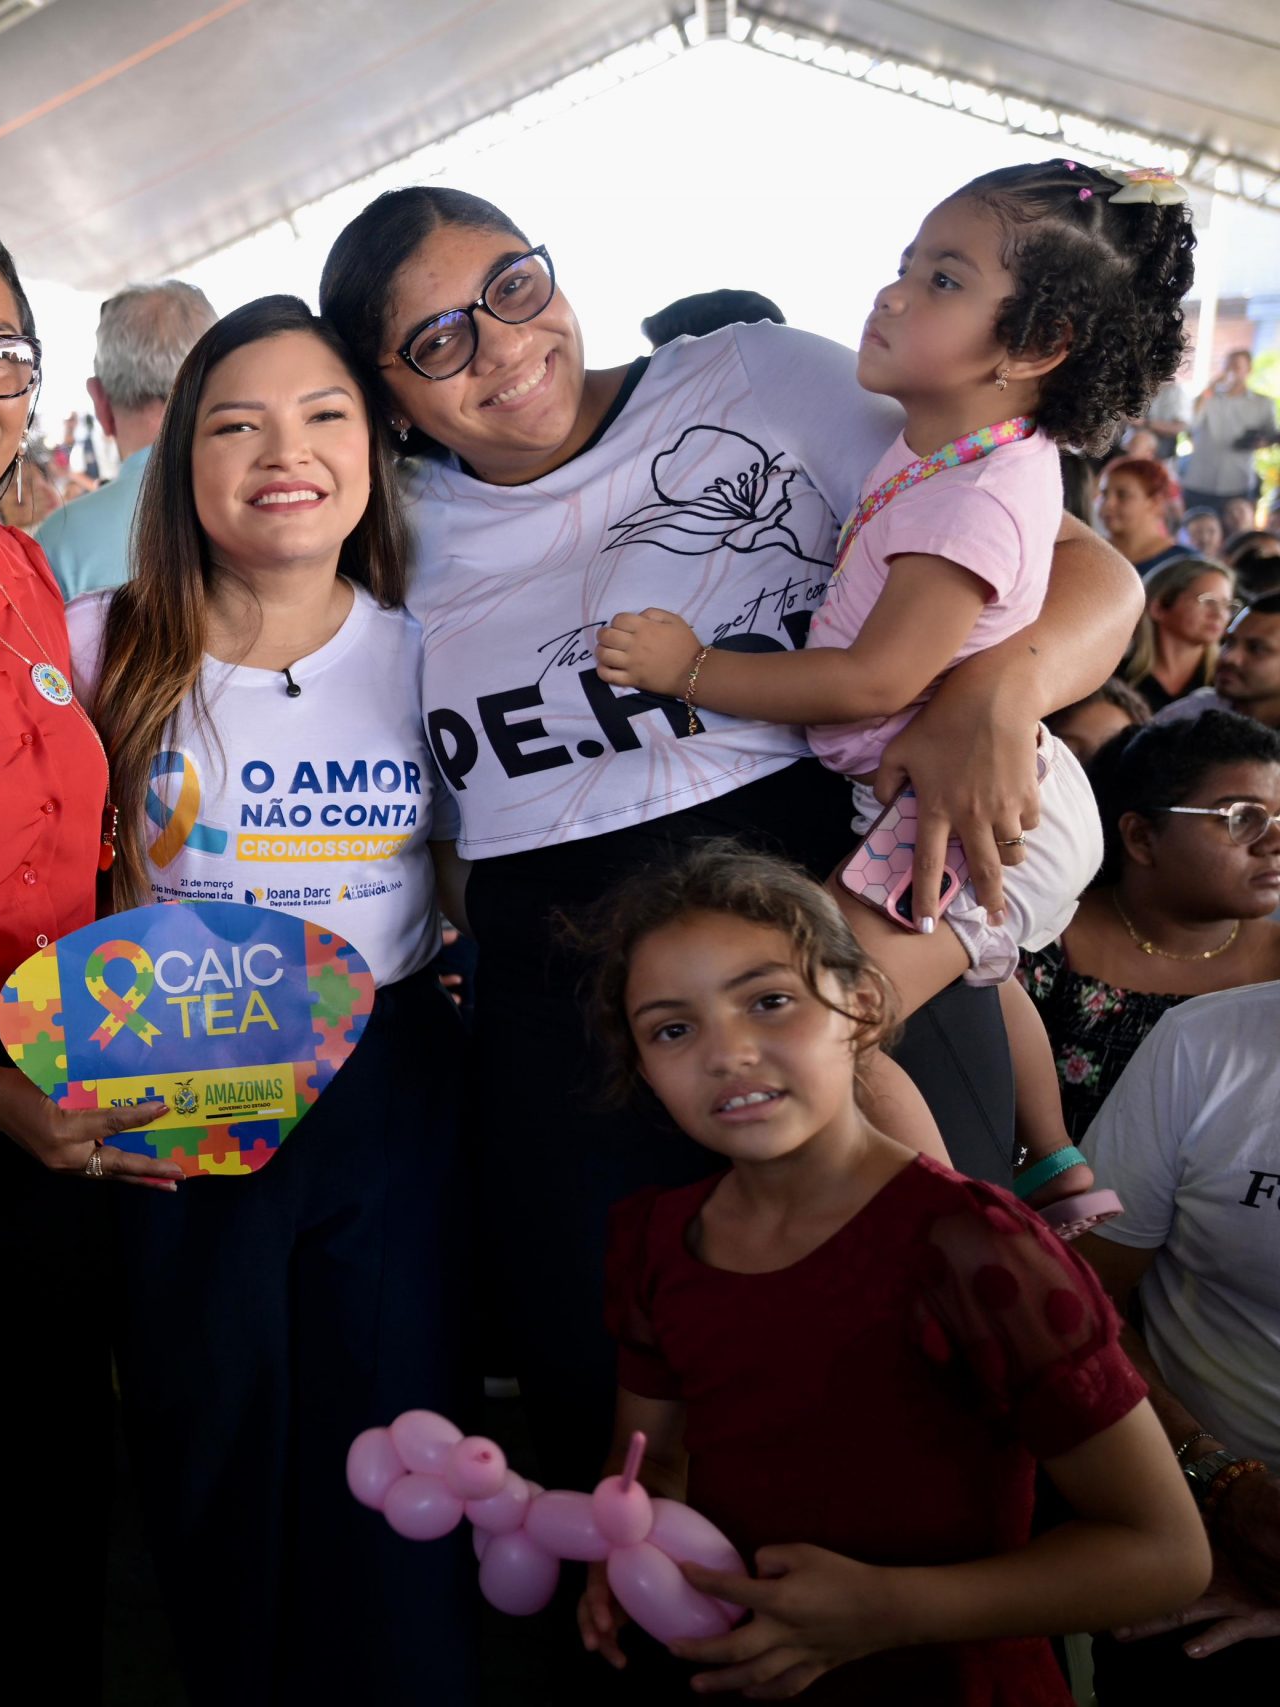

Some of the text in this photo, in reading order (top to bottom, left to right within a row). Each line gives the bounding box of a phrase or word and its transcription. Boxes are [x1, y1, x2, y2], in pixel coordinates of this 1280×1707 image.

[240, 759, 422, 795] O AMOR
[240, 798, 417, 828] NÃO CONTA
[151, 884, 164, 893] Dia
[164, 886, 220, 899] Internacional
[221, 891, 233, 900] da
[180, 879, 188, 887] 21
[190, 879, 202, 887] de
[266, 887, 331, 900] Joana Darc
[270, 900, 301, 908] Deputada
[154, 943, 284, 994] CAIC
[166, 990, 280, 1038] TEA
[204, 1078, 283, 1106] AMAZONAS
